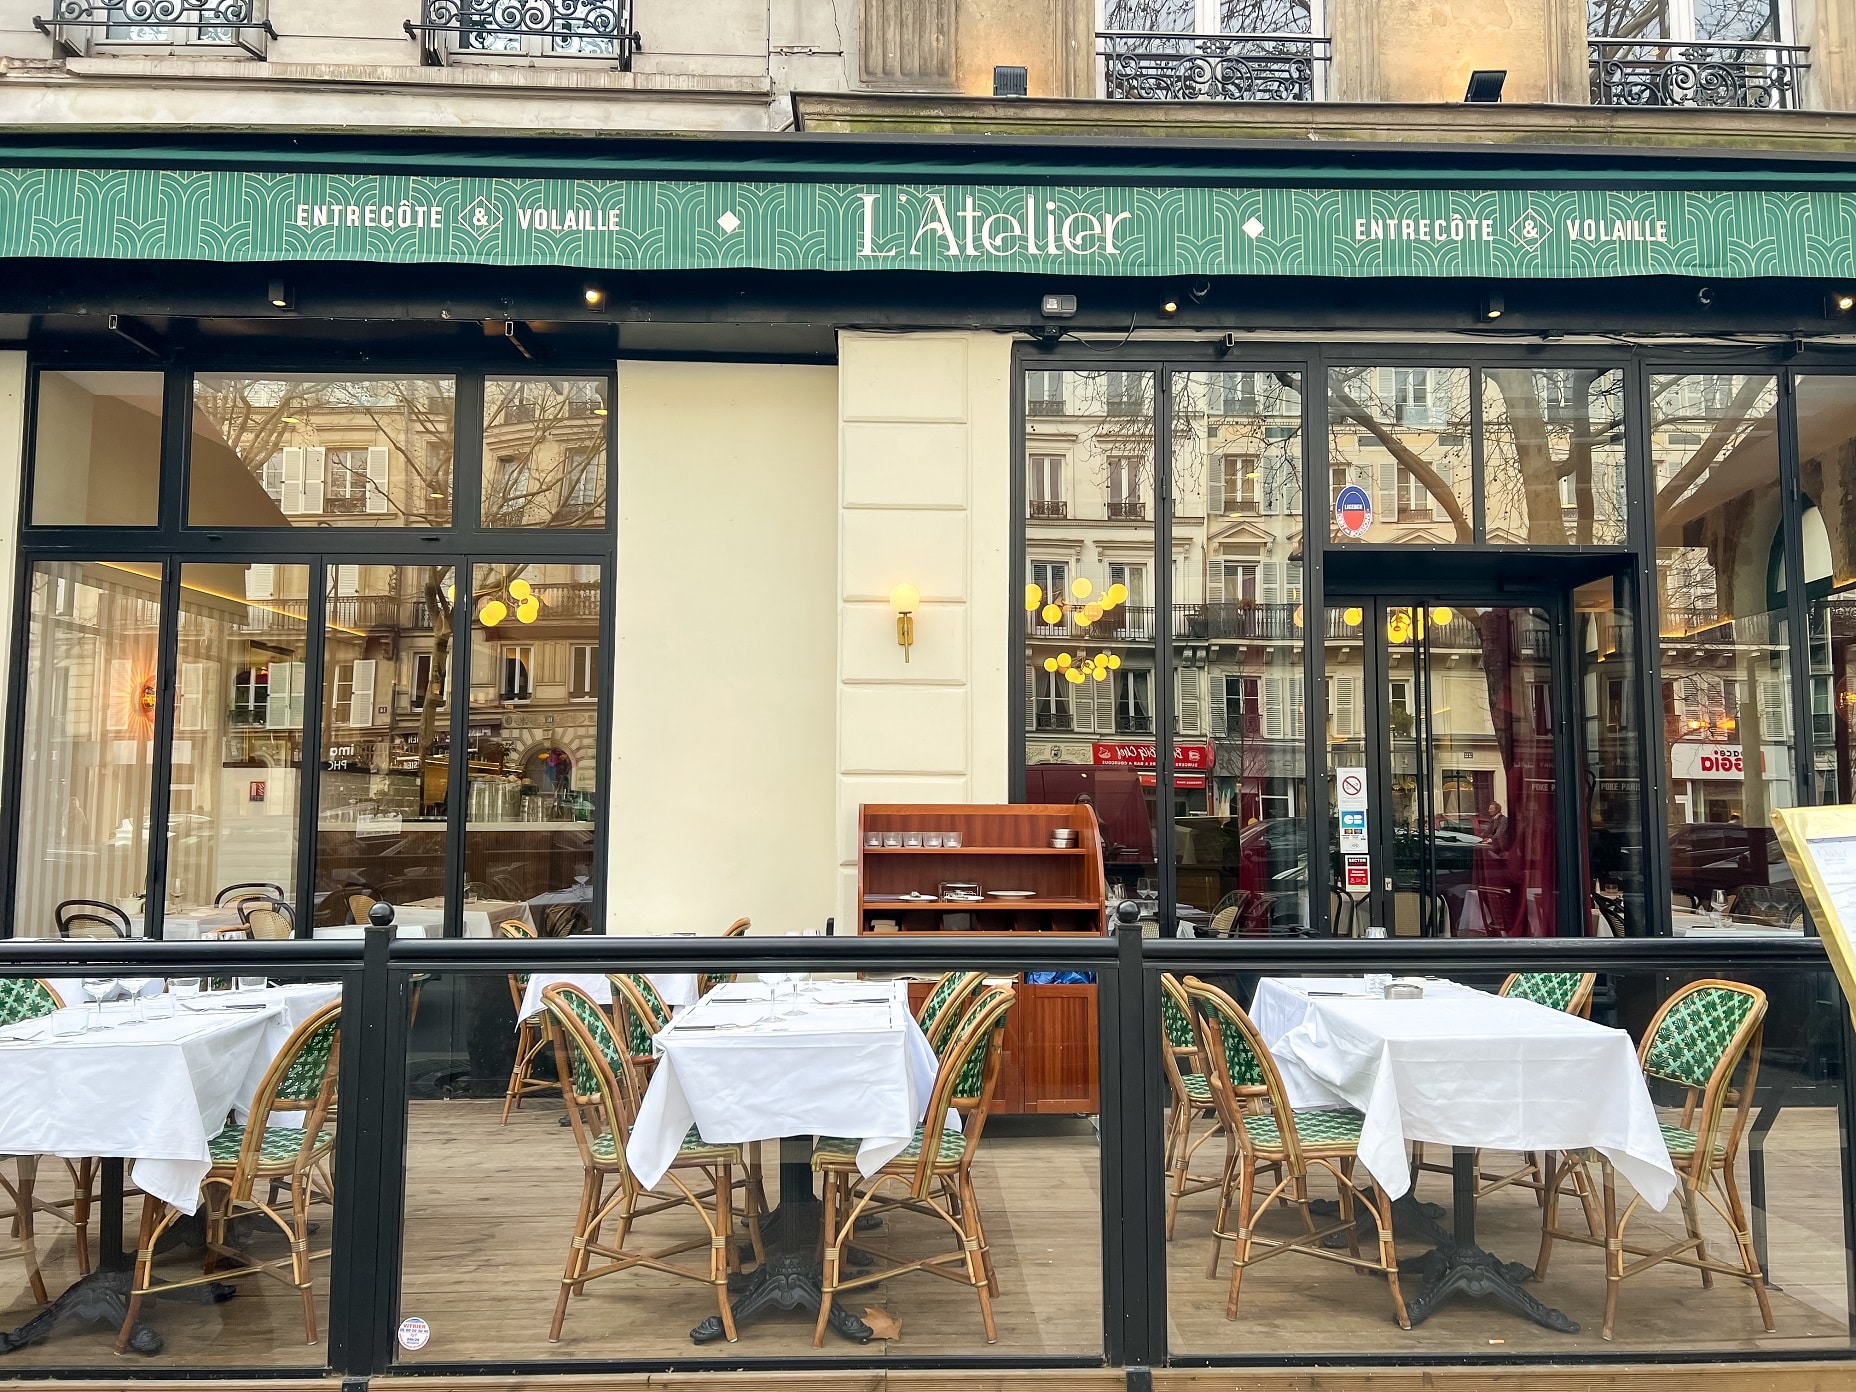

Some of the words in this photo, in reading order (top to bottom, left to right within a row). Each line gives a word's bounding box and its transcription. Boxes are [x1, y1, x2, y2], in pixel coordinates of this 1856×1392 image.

[296, 200, 443, 229] ENTRECÔTE
[472, 208, 489, 227] &
[517, 208, 621, 232] VOLAILLE
[1354, 215, 1495, 241] ENTRECÔTE
[1523, 220, 1539, 239] &
[1566, 218, 1669, 243] VOLAILLE
